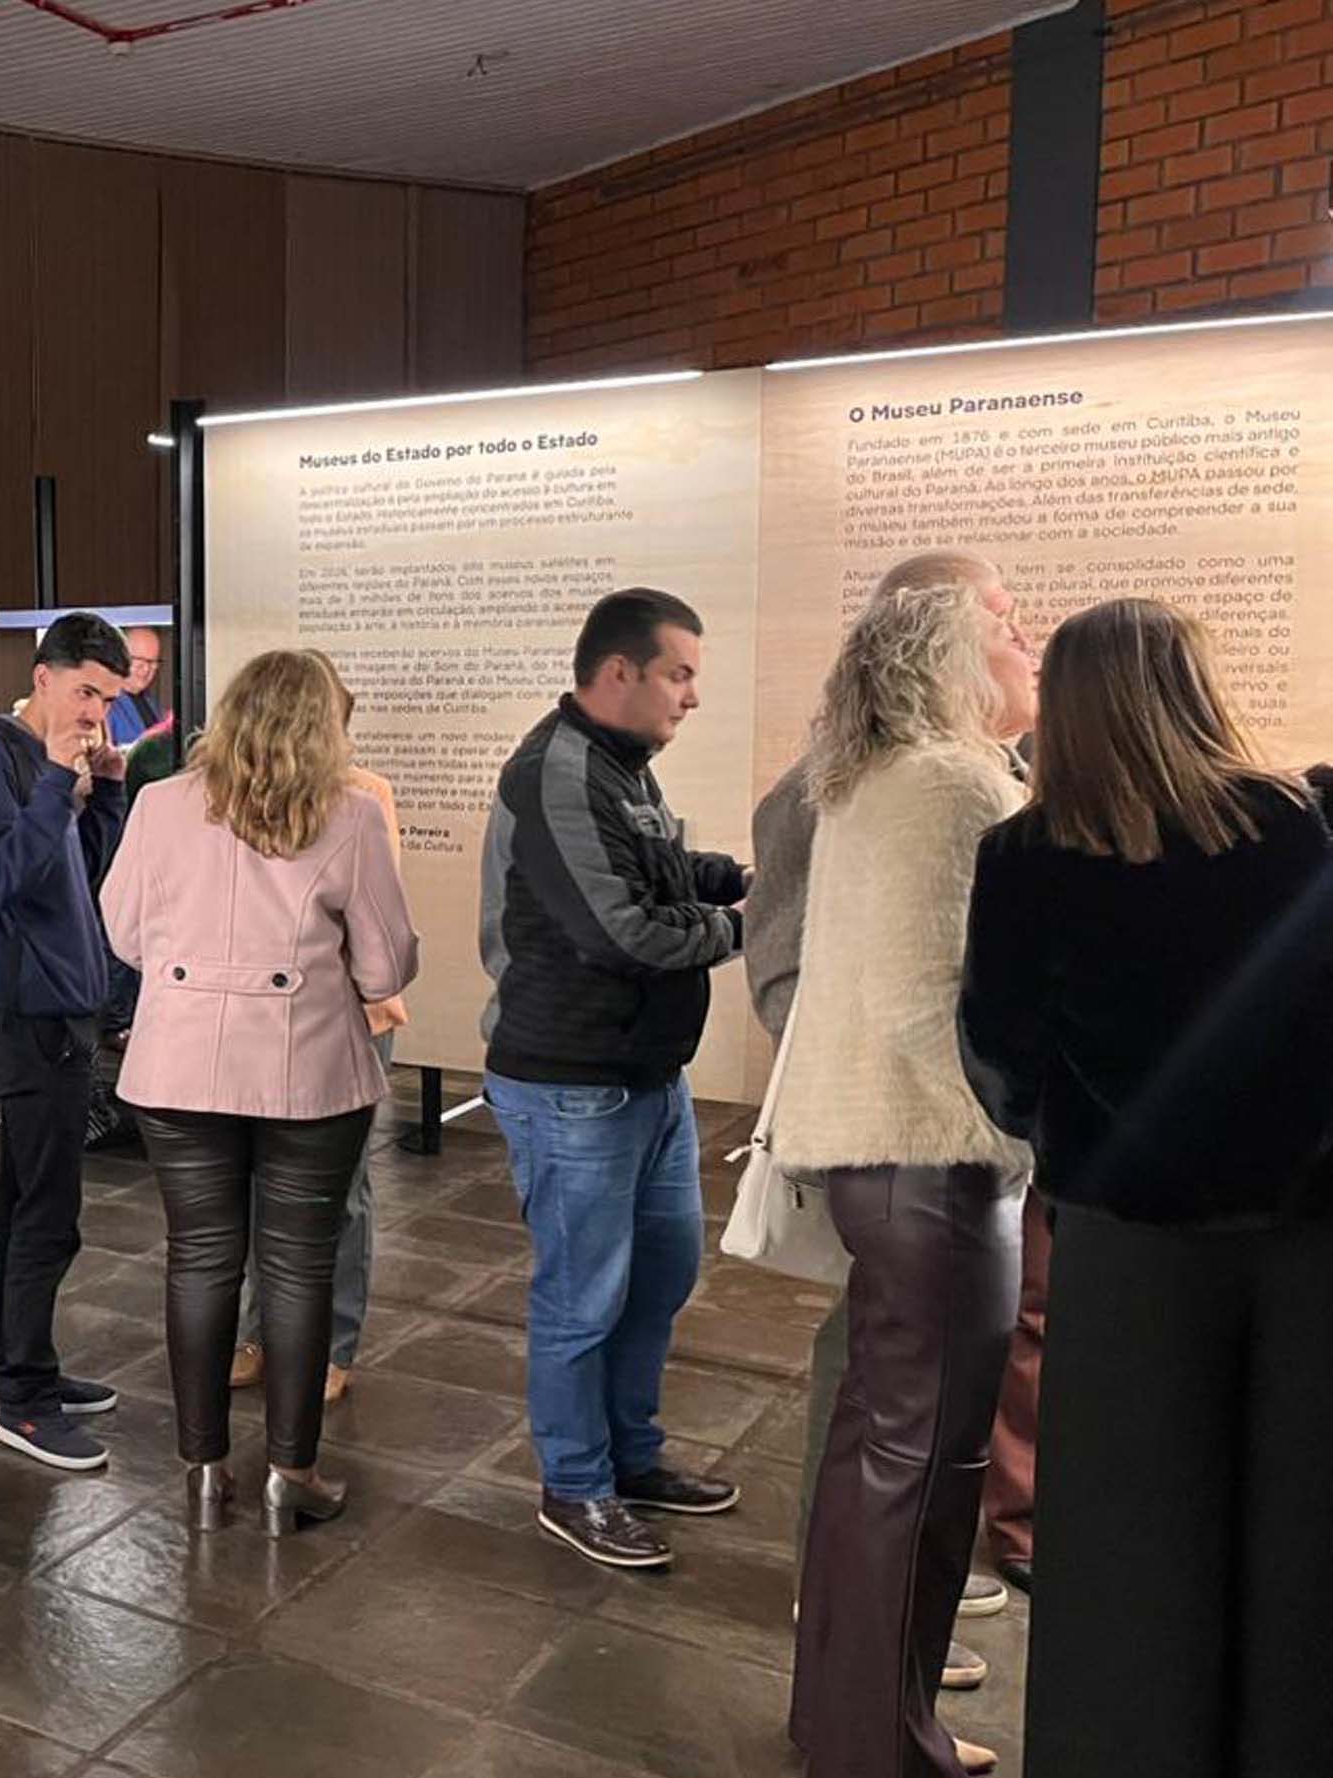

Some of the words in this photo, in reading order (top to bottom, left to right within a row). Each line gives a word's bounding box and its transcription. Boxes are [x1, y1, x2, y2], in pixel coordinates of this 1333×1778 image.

[849, 407, 864, 422] O
[872, 403, 942, 421] Museu
[950, 391, 1083, 414] Paranaense
[299, 454, 358, 469] Museus
[361, 448, 382, 464] do
[386, 444, 442, 462] Estado
[445, 444, 474, 460] por
[478, 437, 517, 454] todo
[521, 439, 533, 451] o
[537, 431, 599, 450] Estado
